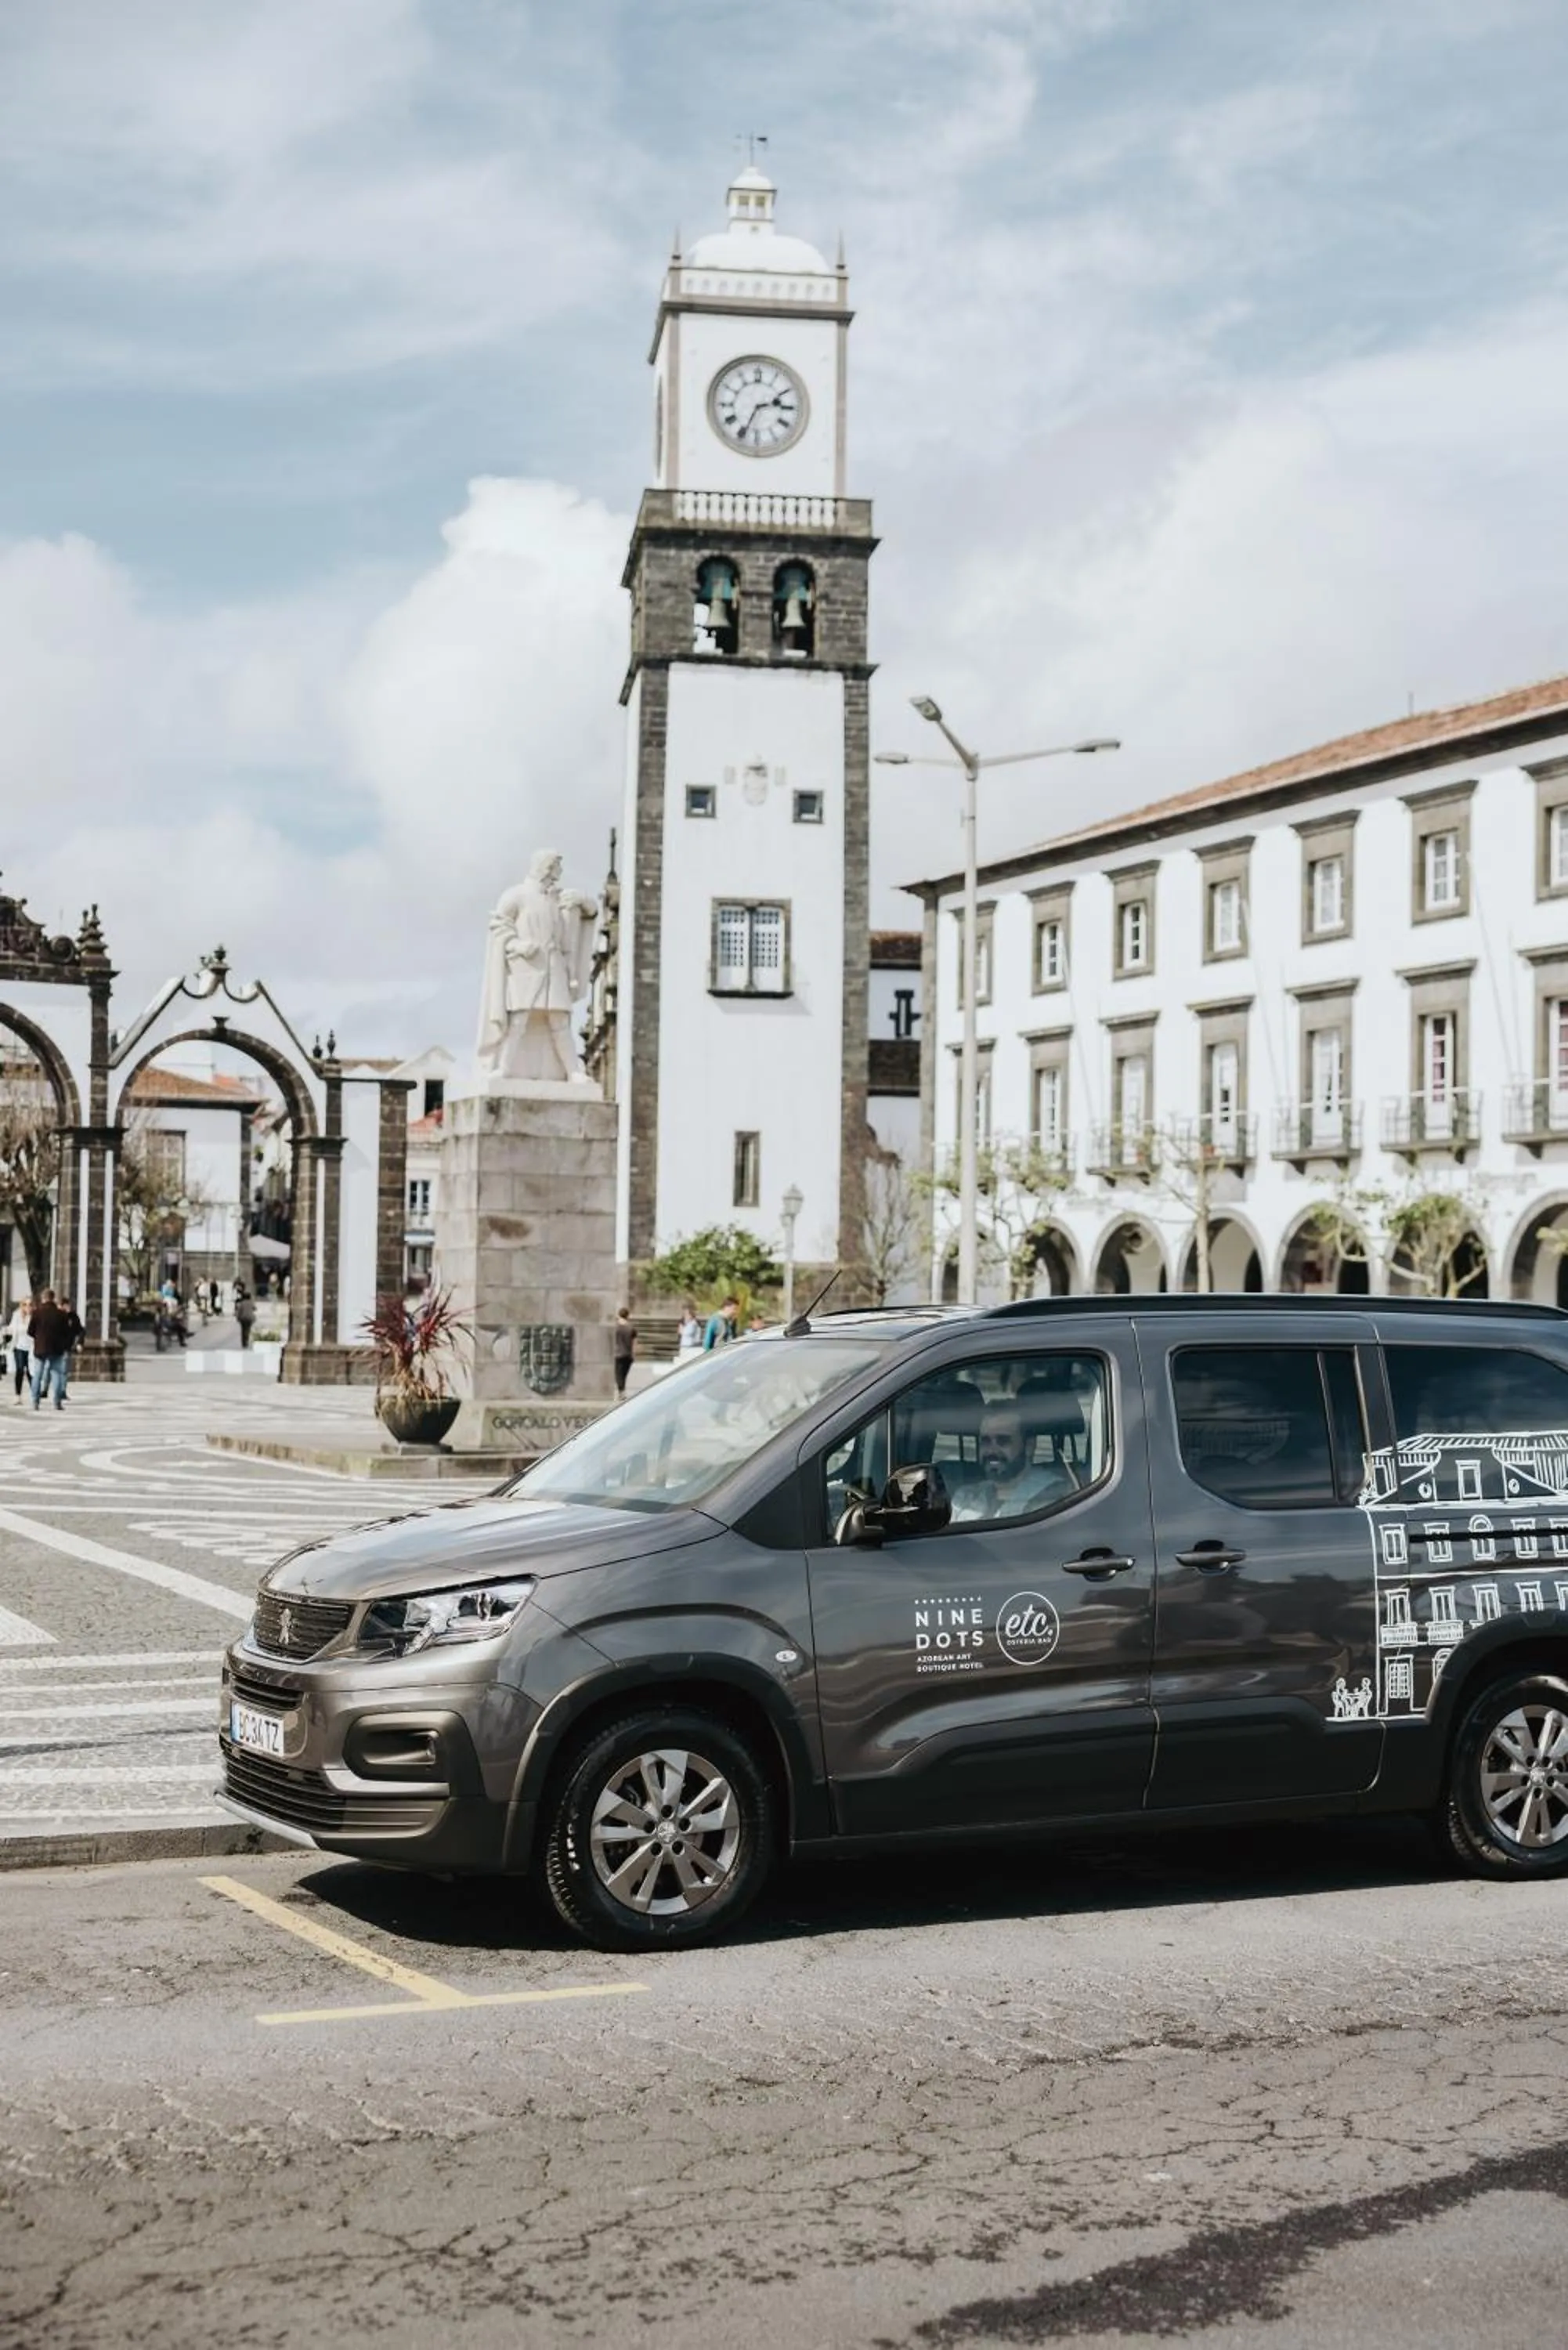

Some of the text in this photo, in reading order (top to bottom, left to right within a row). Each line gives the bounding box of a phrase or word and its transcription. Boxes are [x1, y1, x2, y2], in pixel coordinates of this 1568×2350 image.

[915, 1608, 983, 1627] NINE
[916, 1630, 984, 1650] DOTS
[916, 1661, 984, 1672] BOUTIQUE HOTEL
